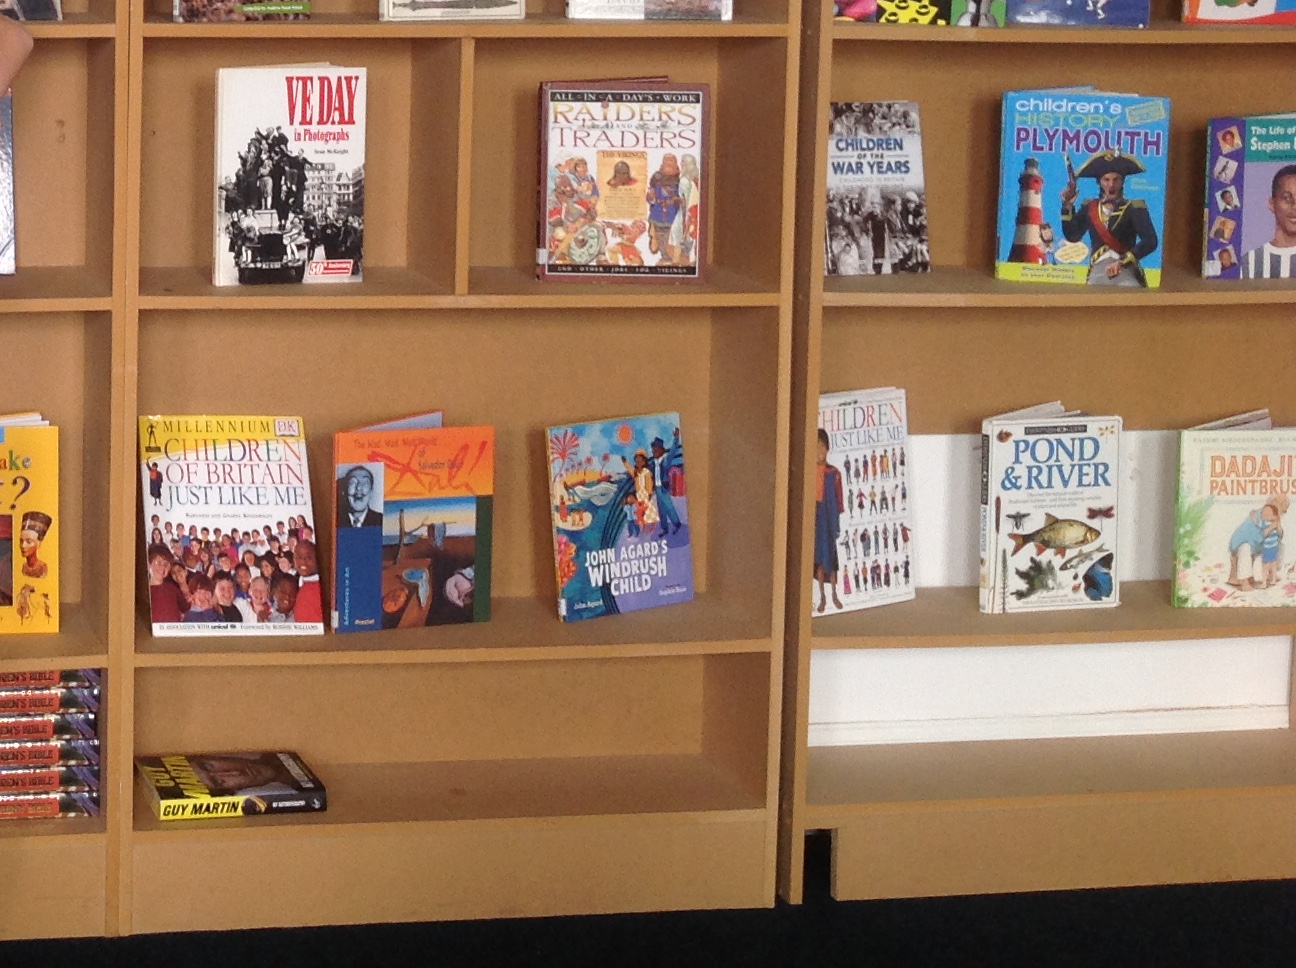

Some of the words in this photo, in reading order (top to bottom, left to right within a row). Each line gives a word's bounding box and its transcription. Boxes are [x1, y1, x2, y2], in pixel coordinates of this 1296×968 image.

[285, 75, 314, 126] VE
[317, 75, 359, 126] DAY
[584, 93, 596, 101] IN
[1015, 98, 1122, 115] children's
[552, 101, 697, 126] RAIDERS
[1015, 113, 1122, 129] HISTORY
[294, 128, 303, 142] in
[304, 128, 350, 144] Photographs
[551, 127, 697, 149] TRADERS
[1251, 126, 1267, 135] The
[1269, 126, 1285, 135] Life
[835, 138, 903, 152] CHILDREN
[1014, 127, 1163, 157] PLYMOUTH
[1250, 136, 1290, 153] Stephen
[831, 161, 864, 174] WAR
[867, 161, 910, 174] YEARS
[163, 420, 271, 433] MILLENNIUM
[277, 421, 296, 433] DK
[820, 402, 902, 432] HILDREN
[829, 431, 852, 449] JUST
[854, 428, 885, 445] LIKE
[887, 426, 903, 440] ME
[164, 438, 303, 462] CHILDREN
[1012, 437, 1100, 465] POND
[166, 463, 199, 484] OF
[205, 463, 304, 485] BRITAIN
[1000, 466, 1023, 491] &
[1025, 462, 1112, 490] RIVER
[165, 486, 212, 512] JUST
[219, 486, 269, 505] LIKE
[274, 486, 307, 505] ME
[585, 547, 616, 567] JOHN
[620, 539, 668, 560] AGARD'S
[588, 556, 667, 587] WINDRUSH
[610, 574, 652, 596] CHILD
[162, 803, 186, 817] GUY
[190, 801, 239, 815] MARTIN
